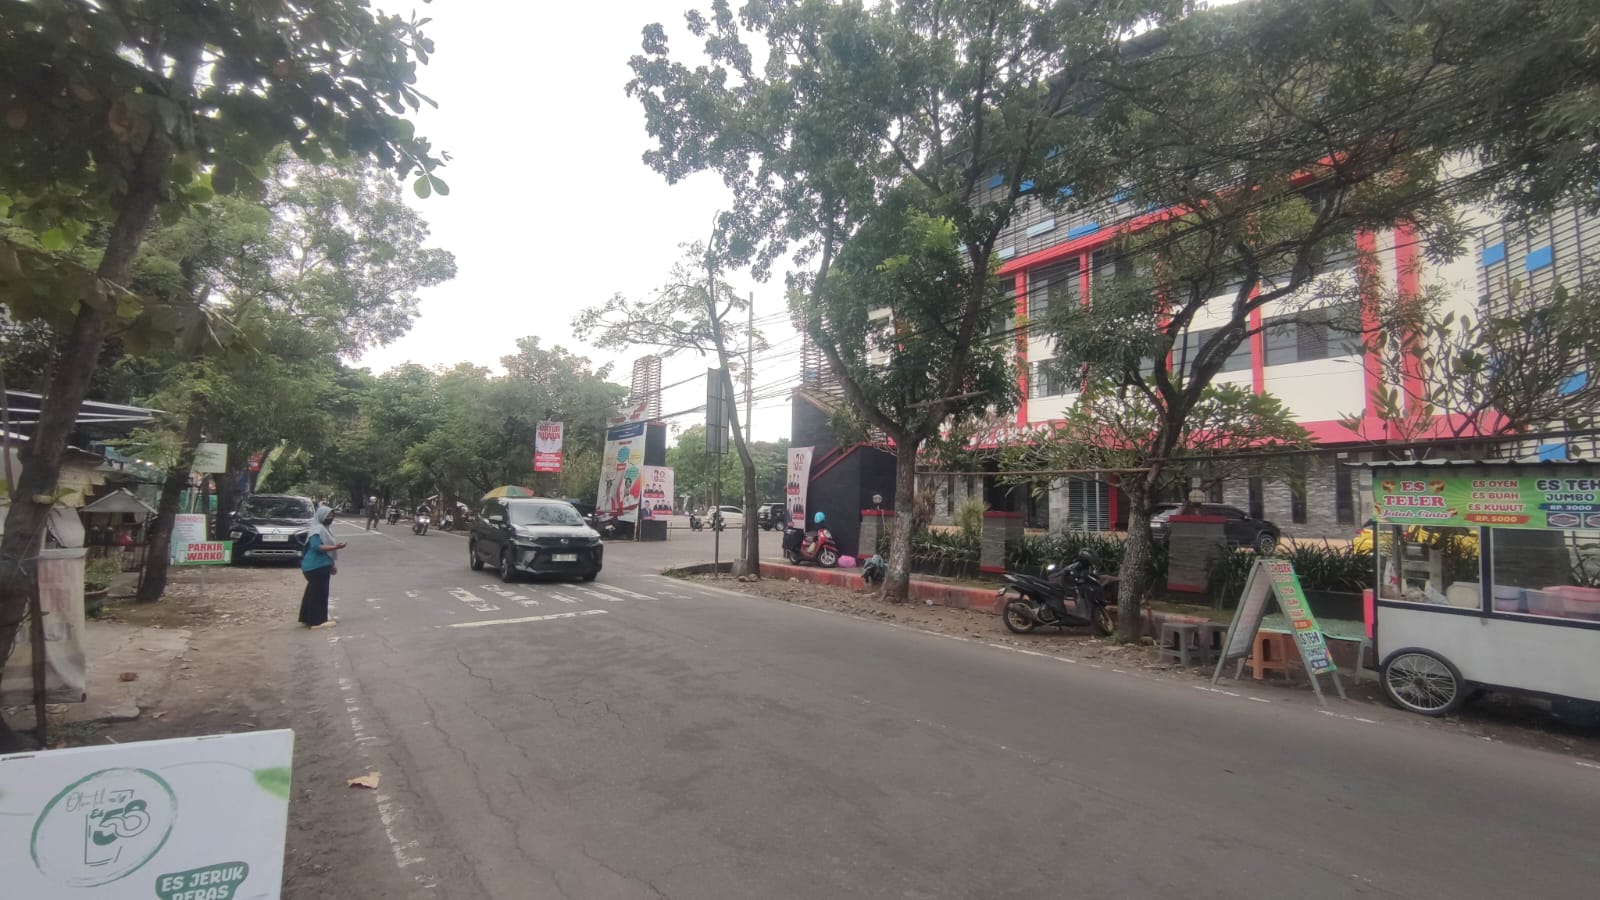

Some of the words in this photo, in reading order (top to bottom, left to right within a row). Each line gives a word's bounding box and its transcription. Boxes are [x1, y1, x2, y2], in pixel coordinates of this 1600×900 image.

[1401, 481, 1425, 492] ES
[1537, 479, 1560, 490] ES
[1566, 479, 1600, 490] TEH
[1383, 495, 1445, 507] TELER
[1546, 493, 1595, 501] JUMBO
[187, 543, 223, 551] PARKIR
[187, 552, 223, 561] WARKO
[161, 876, 184, 892] ES
[189, 866, 244, 887] JERUK
